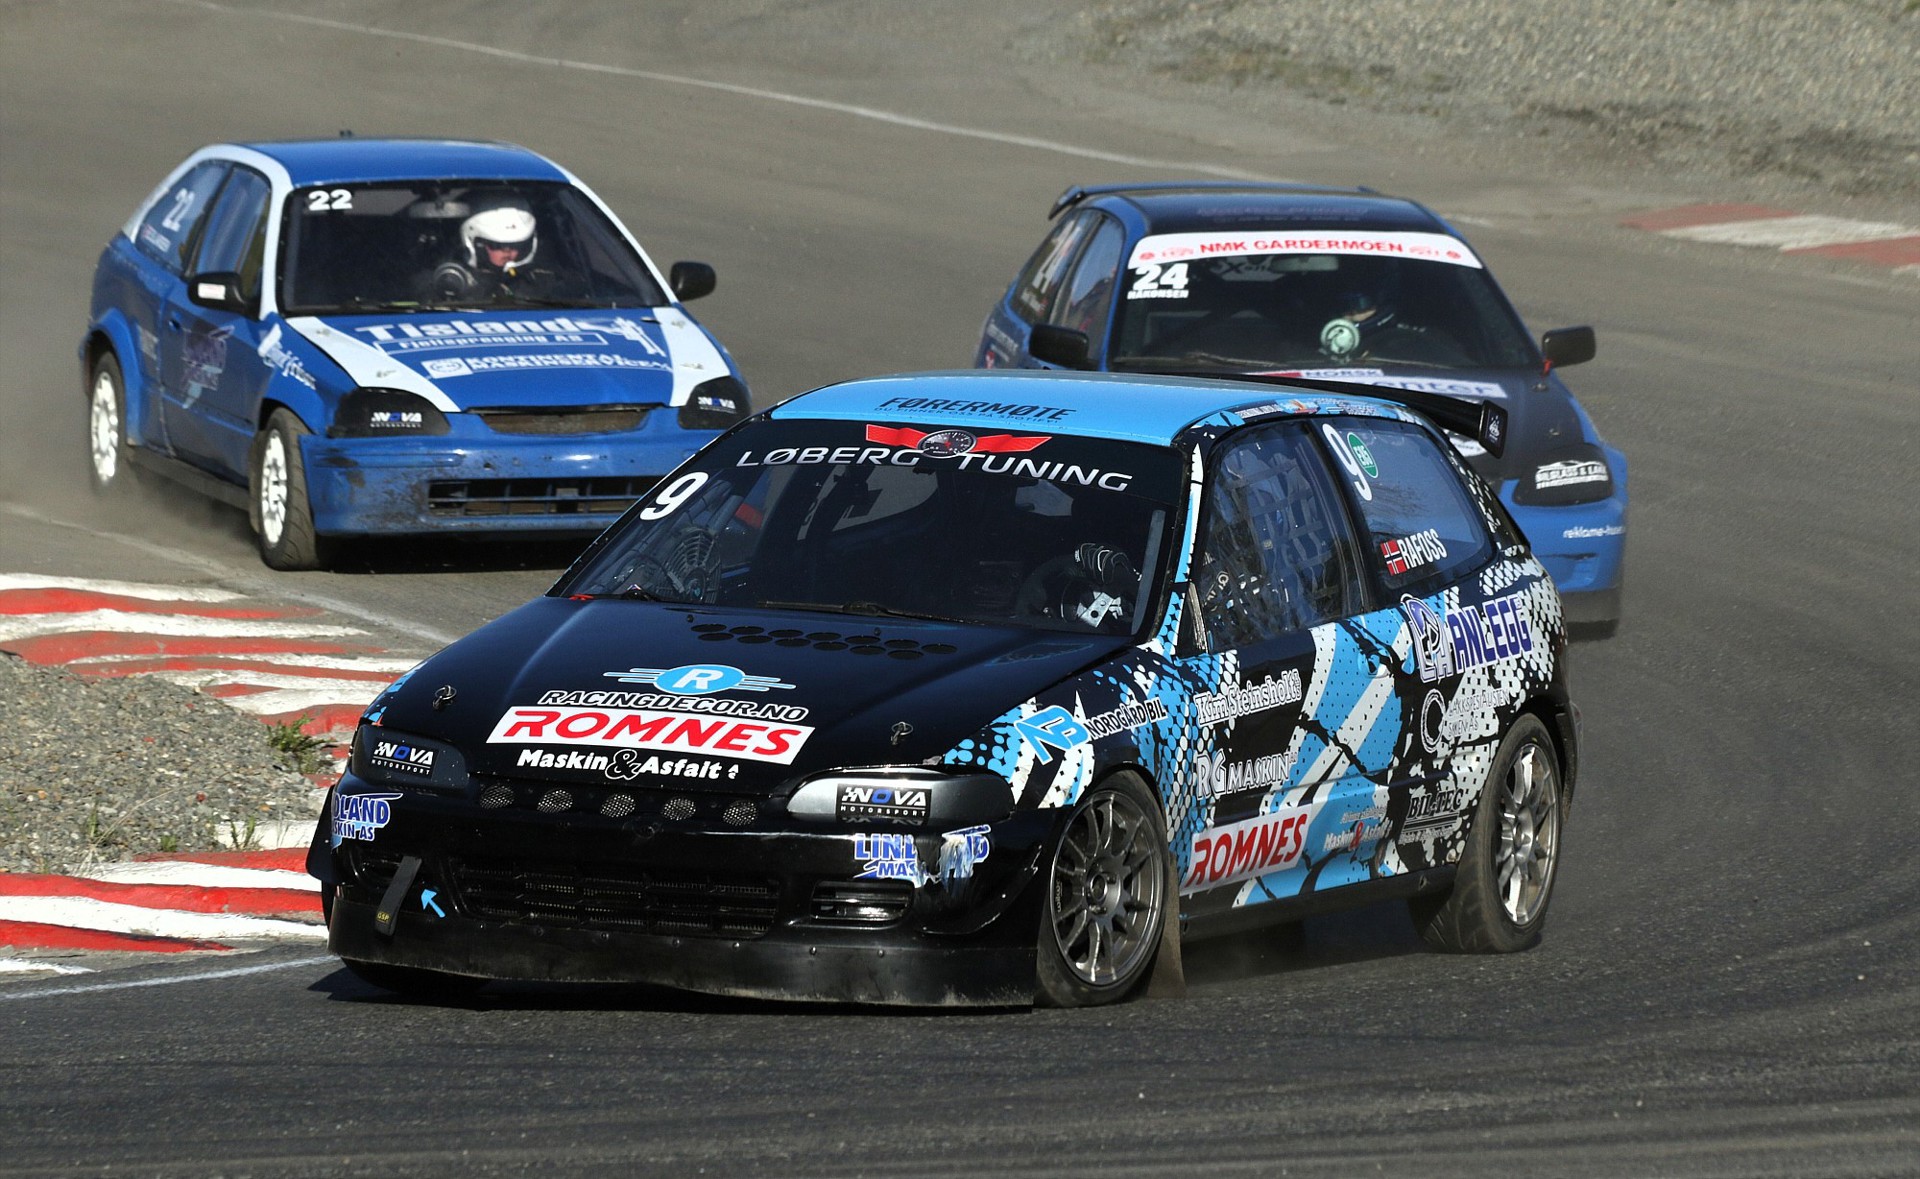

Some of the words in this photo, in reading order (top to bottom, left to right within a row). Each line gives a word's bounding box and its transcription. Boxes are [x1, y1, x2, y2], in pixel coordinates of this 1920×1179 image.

[308, 189, 353, 211] 22
[1200, 241, 1247, 254] NMK
[1254, 240, 1403, 252] GARDERMOEN
[1133, 262, 1189, 290] 24
[880, 396, 1077, 420] FØRERMØTE
[736, 446, 923, 468] LØBERG
[954, 452, 1134, 492] TUNING
[1322, 423, 1372, 501] 9
[639, 472, 709, 521] 9
[1397, 528, 1448, 570] RAFOSS
[1447, 593, 1533, 674] ANLEGG
[672, 668, 724, 690] R
[537, 690, 808, 722] RACINGDECOR.NO
[1193, 690, 1229, 727] Kim
[1228, 669, 1297, 719] Steinsholt
[503, 710, 802, 756] ROMNES
[1083, 703, 1146, 741] NORDGÅRD
[1146, 696, 1169, 724] BIL
[371, 759, 430, 775] MOTORSPORT
[373, 741, 434, 765] NOVA
[516, 749, 609, 771] Maskin
[604, 748, 642, 781] &
[639, 755, 723, 779] Asfalt
[1196, 748, 1226, 800] RG
[1226, 752, 1290, 794] MASKIN
[840, 805, 926, 817] MOTORSPORT
[842, 786, 927, 807] NOVA
[359, 825, 375, 841] AS
[1185, 813, 1308, 888] ROMNES
